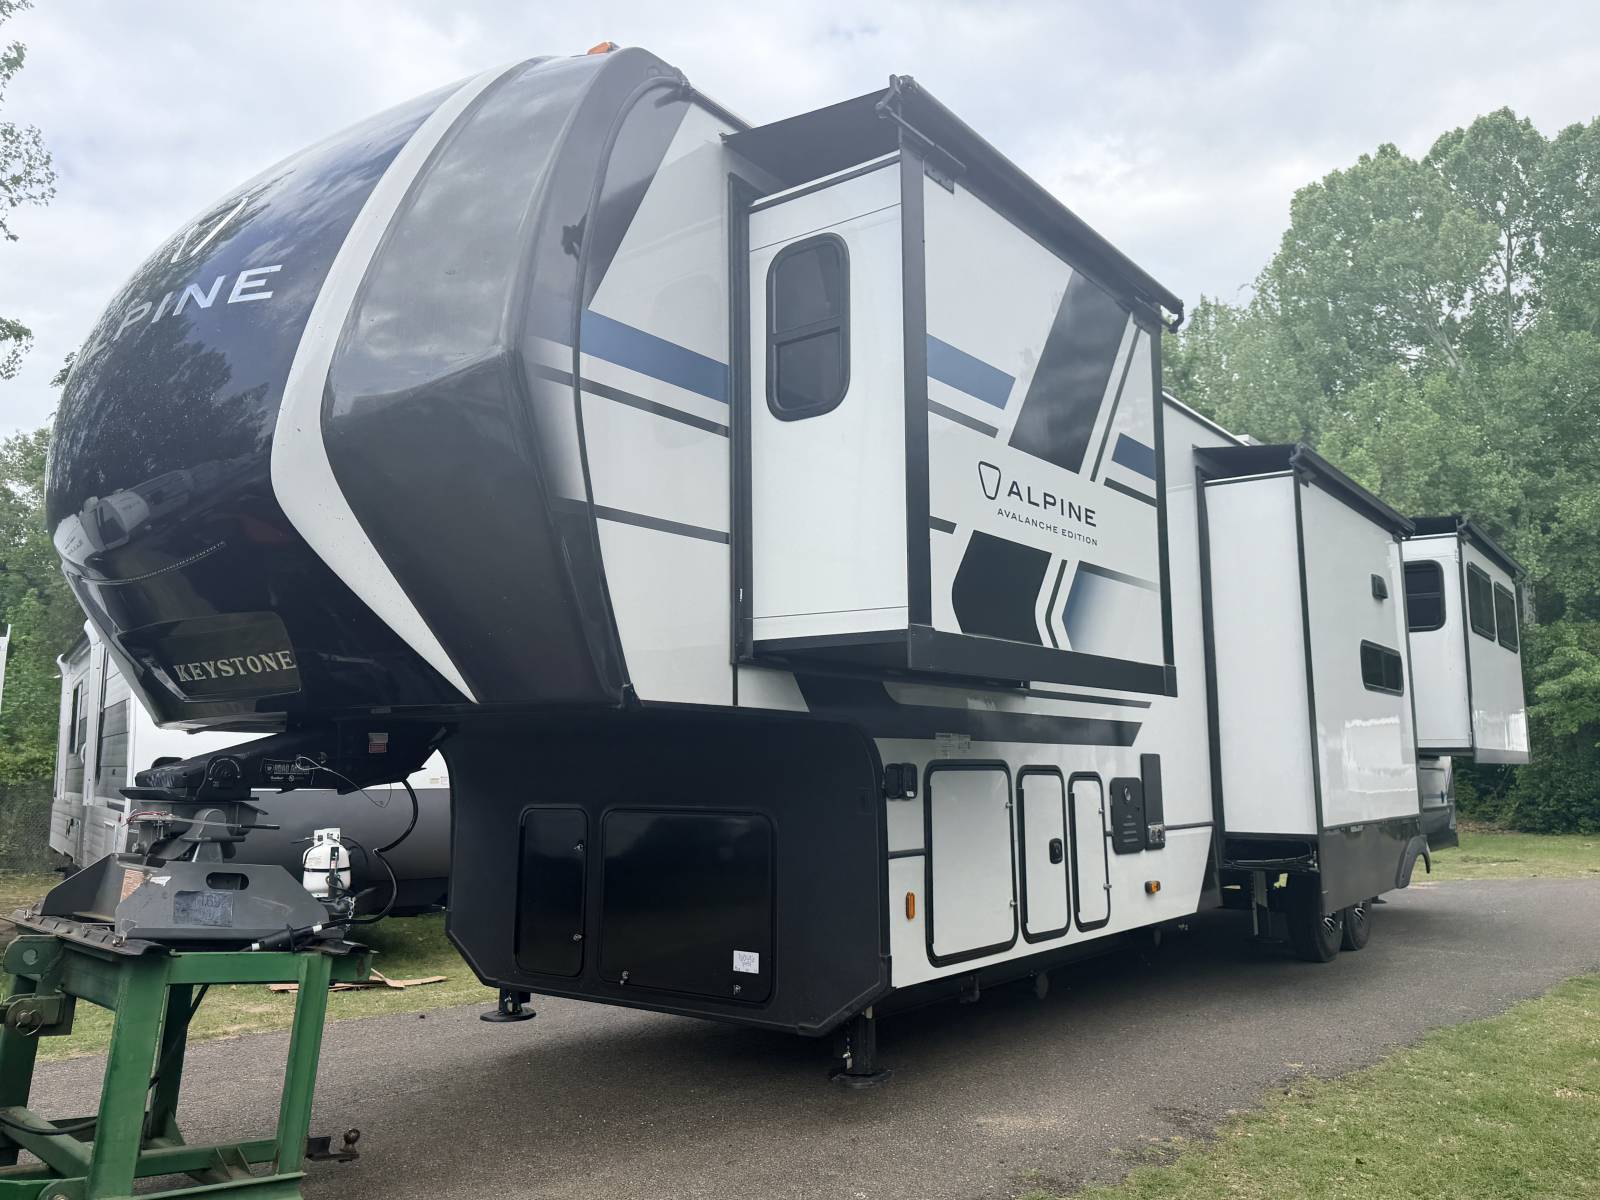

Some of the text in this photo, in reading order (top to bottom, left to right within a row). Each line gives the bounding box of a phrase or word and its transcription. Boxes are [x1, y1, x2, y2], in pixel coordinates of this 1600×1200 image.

[1008, 480, 1097, 527] ALPINE
[998, 508, 1098, 546] AVALANCHE EDITION
[174, 651, 297, 682] KEYSTONE
